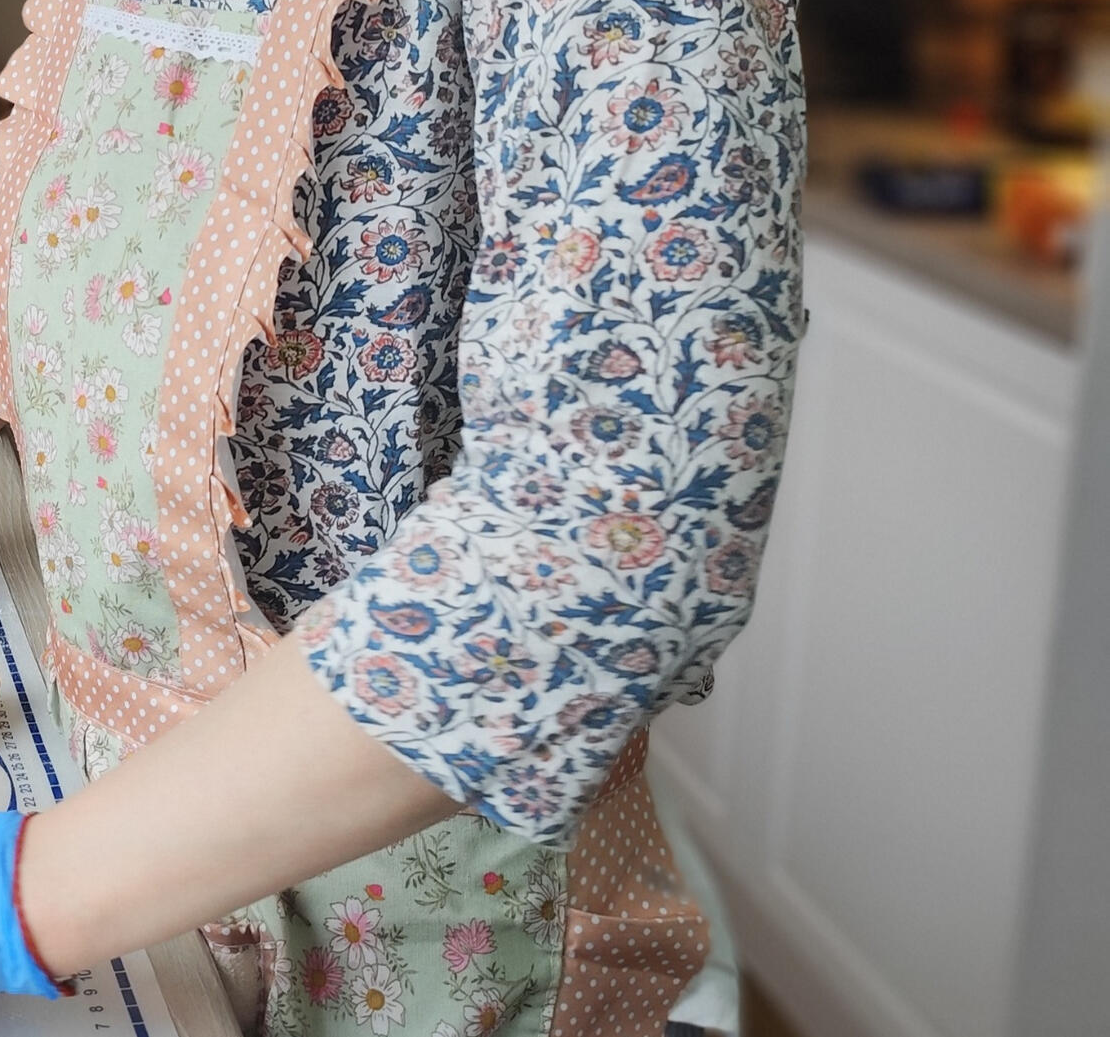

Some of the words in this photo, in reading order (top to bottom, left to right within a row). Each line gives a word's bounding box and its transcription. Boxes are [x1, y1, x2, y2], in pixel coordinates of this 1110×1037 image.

[1, 730, 14, 741] 28
[4, 741, 18, 750] 27
[8, 752, 21, 762] 26
[11, 762, 25, 772] 25
[15, 772, 29, 782] 24
[18, 783, 33, 794] 23
[22, 796, 37, 808] 22
[77, 969, 93, 981] 10
[83, 988, 98, 996] 9
